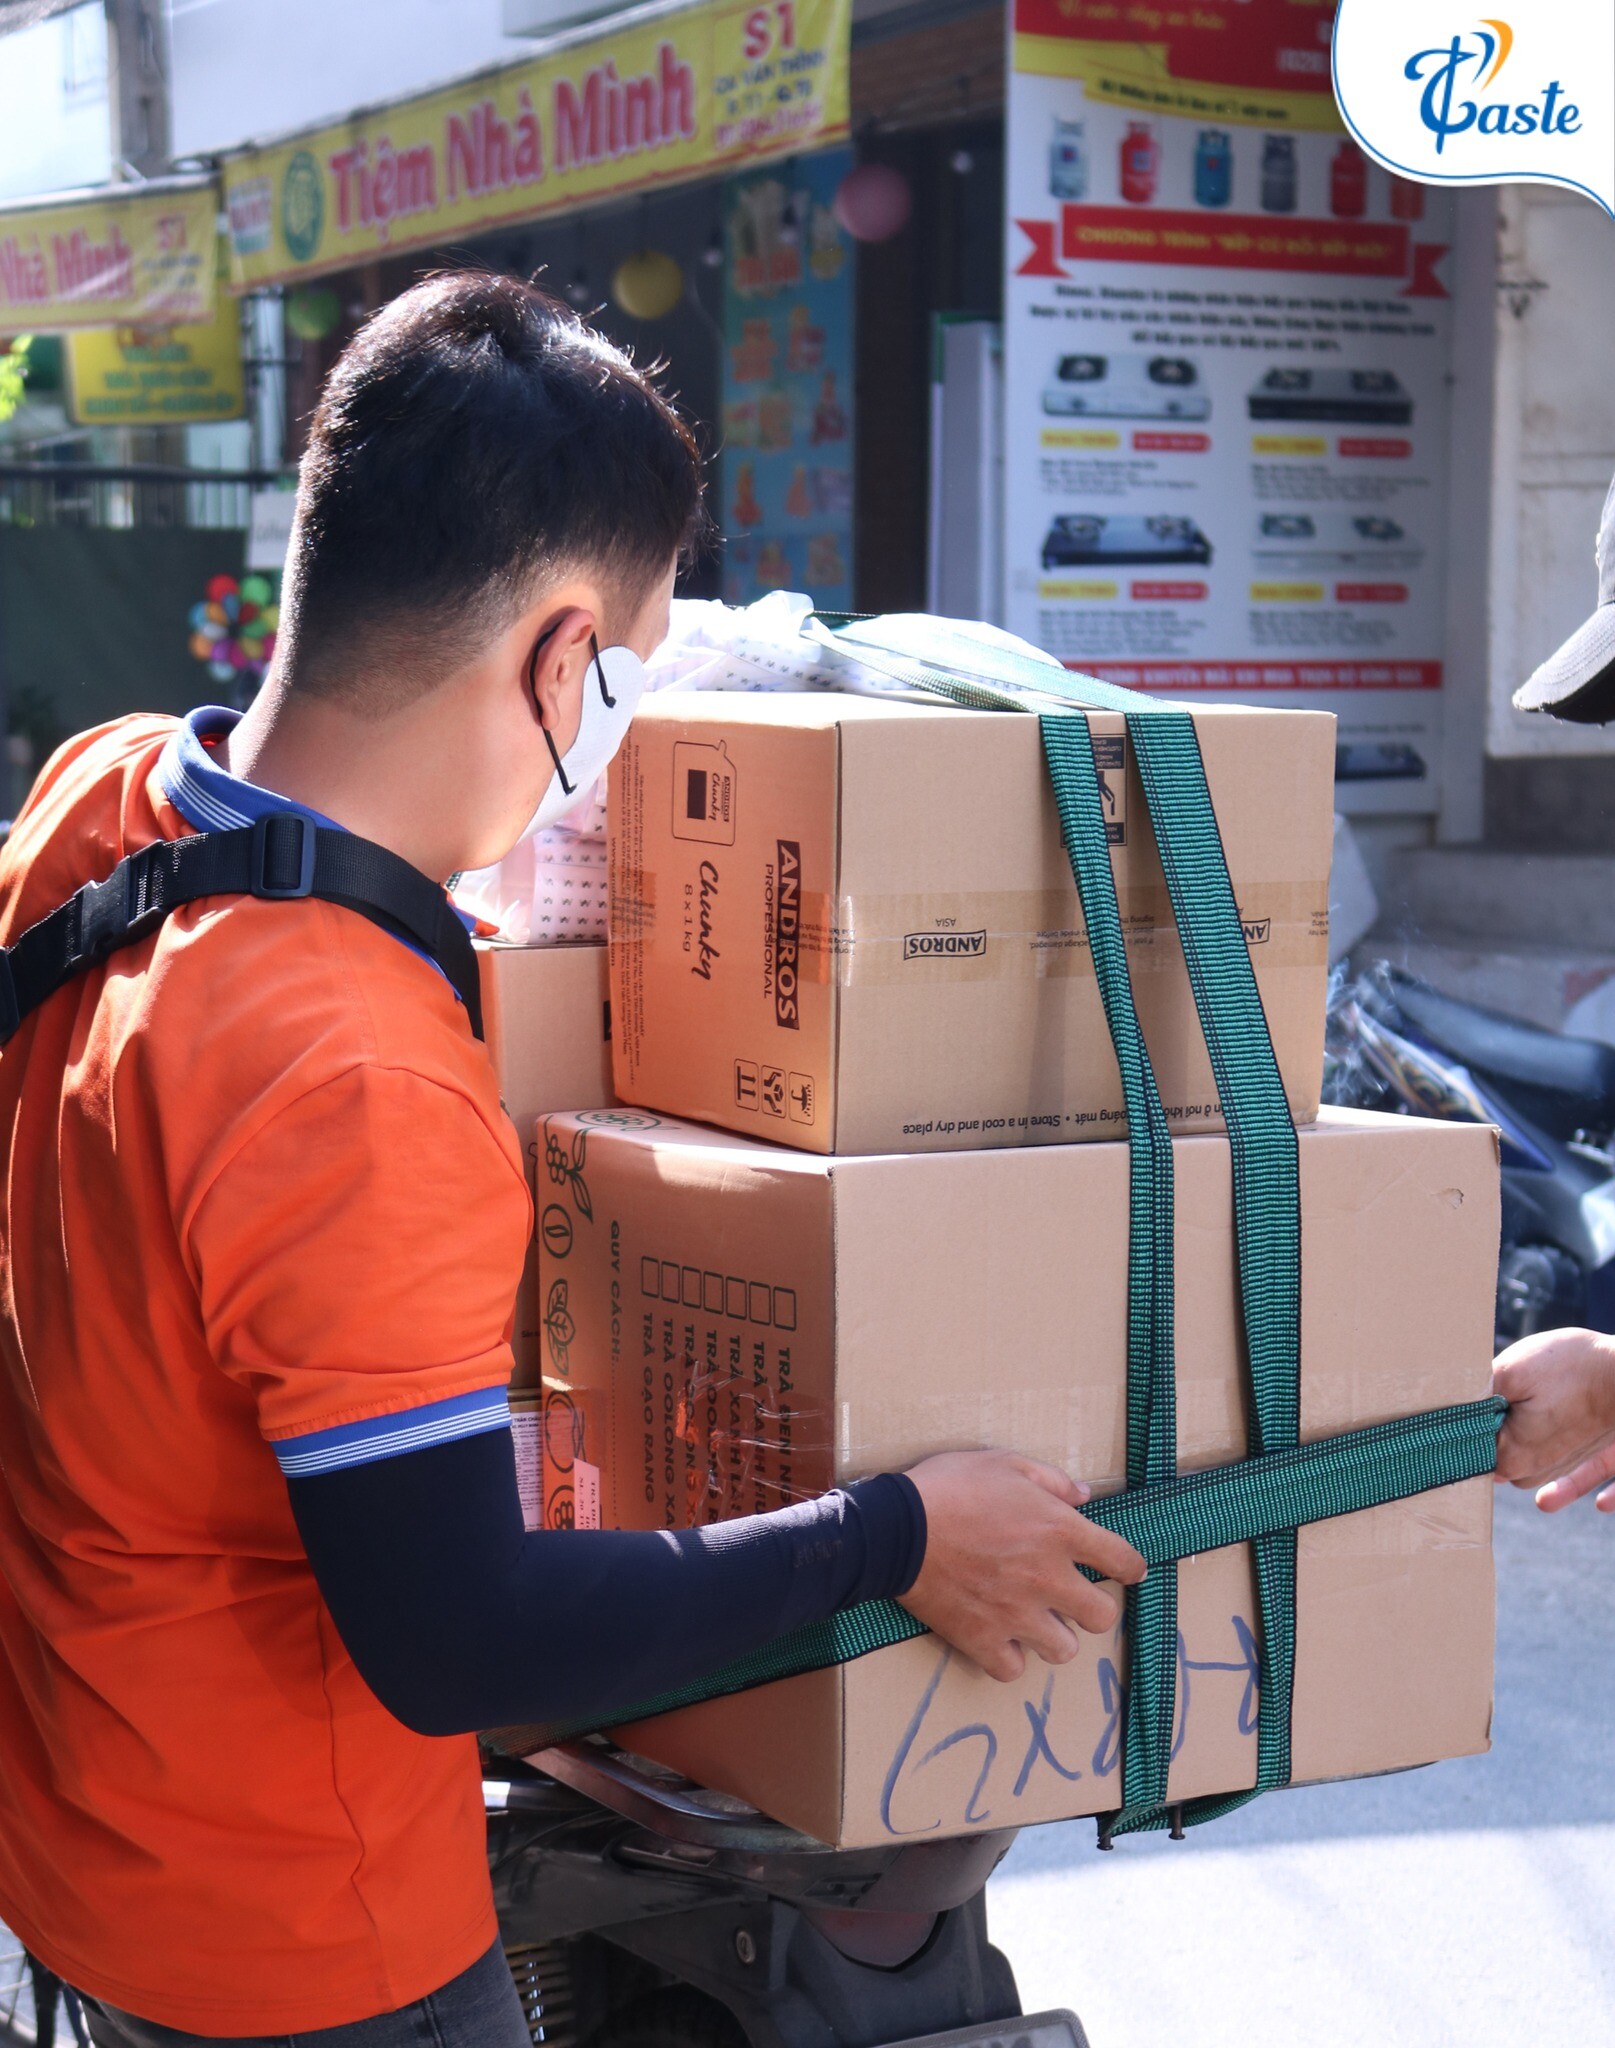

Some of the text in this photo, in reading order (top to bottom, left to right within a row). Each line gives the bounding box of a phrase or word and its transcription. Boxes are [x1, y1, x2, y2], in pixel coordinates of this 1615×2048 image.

[330, 138, 436, 242] Tiệm
[709, 771, 721, 821] Chunky
[682, 884, 694, 952] 8 x 1 kg
[691, 860, 721, 981] Chunky
[764, 863, 776, 1000] PROFESSIONAL
[777, 843, 799, 1022] ANDROS
[935, 918, 957, 928] ASIA
[1244, 925, 1267, 941] AN
[908, 936, 984, 956] ANDROS
[903, 1120, 934, 1136] place
[936, 1120, 957, 1134] dry
[959, 1120, 981, 1132] and
[983, 1118, 1007, 1130] cool
[1008, 1117, 1017, 1126] a
[1019, 1117, 1030, 1128] in
[1031, 1115, 1062, 1127] Store
[1075, 1112, 1098, 1124] mát
[1101, 1109, 1128, 1124] oáng
[610, 1220, 620, 1274] QUY
[684, 1325, 698, 1370] TRÀ
[706, 1330, 721, 1373] TRÀ
[729, 1335, 744, 1381] TRÀ
[754, 1341, 769, 1388] TRÀ
[778, 1347, 794, 1394] TRÀ
[641, 1313, 655, 1505] TRÀ GẠO RANG
[663, 1319, 676, 1528] TRÀ OOLONG XA
[729, 1391, 742, 1465] XANH
[685, 1376, 697, 1491] OOLONG
[706, 1381, 718, 1501] OOLONG
[778, 1464, 793, 1507] NG
